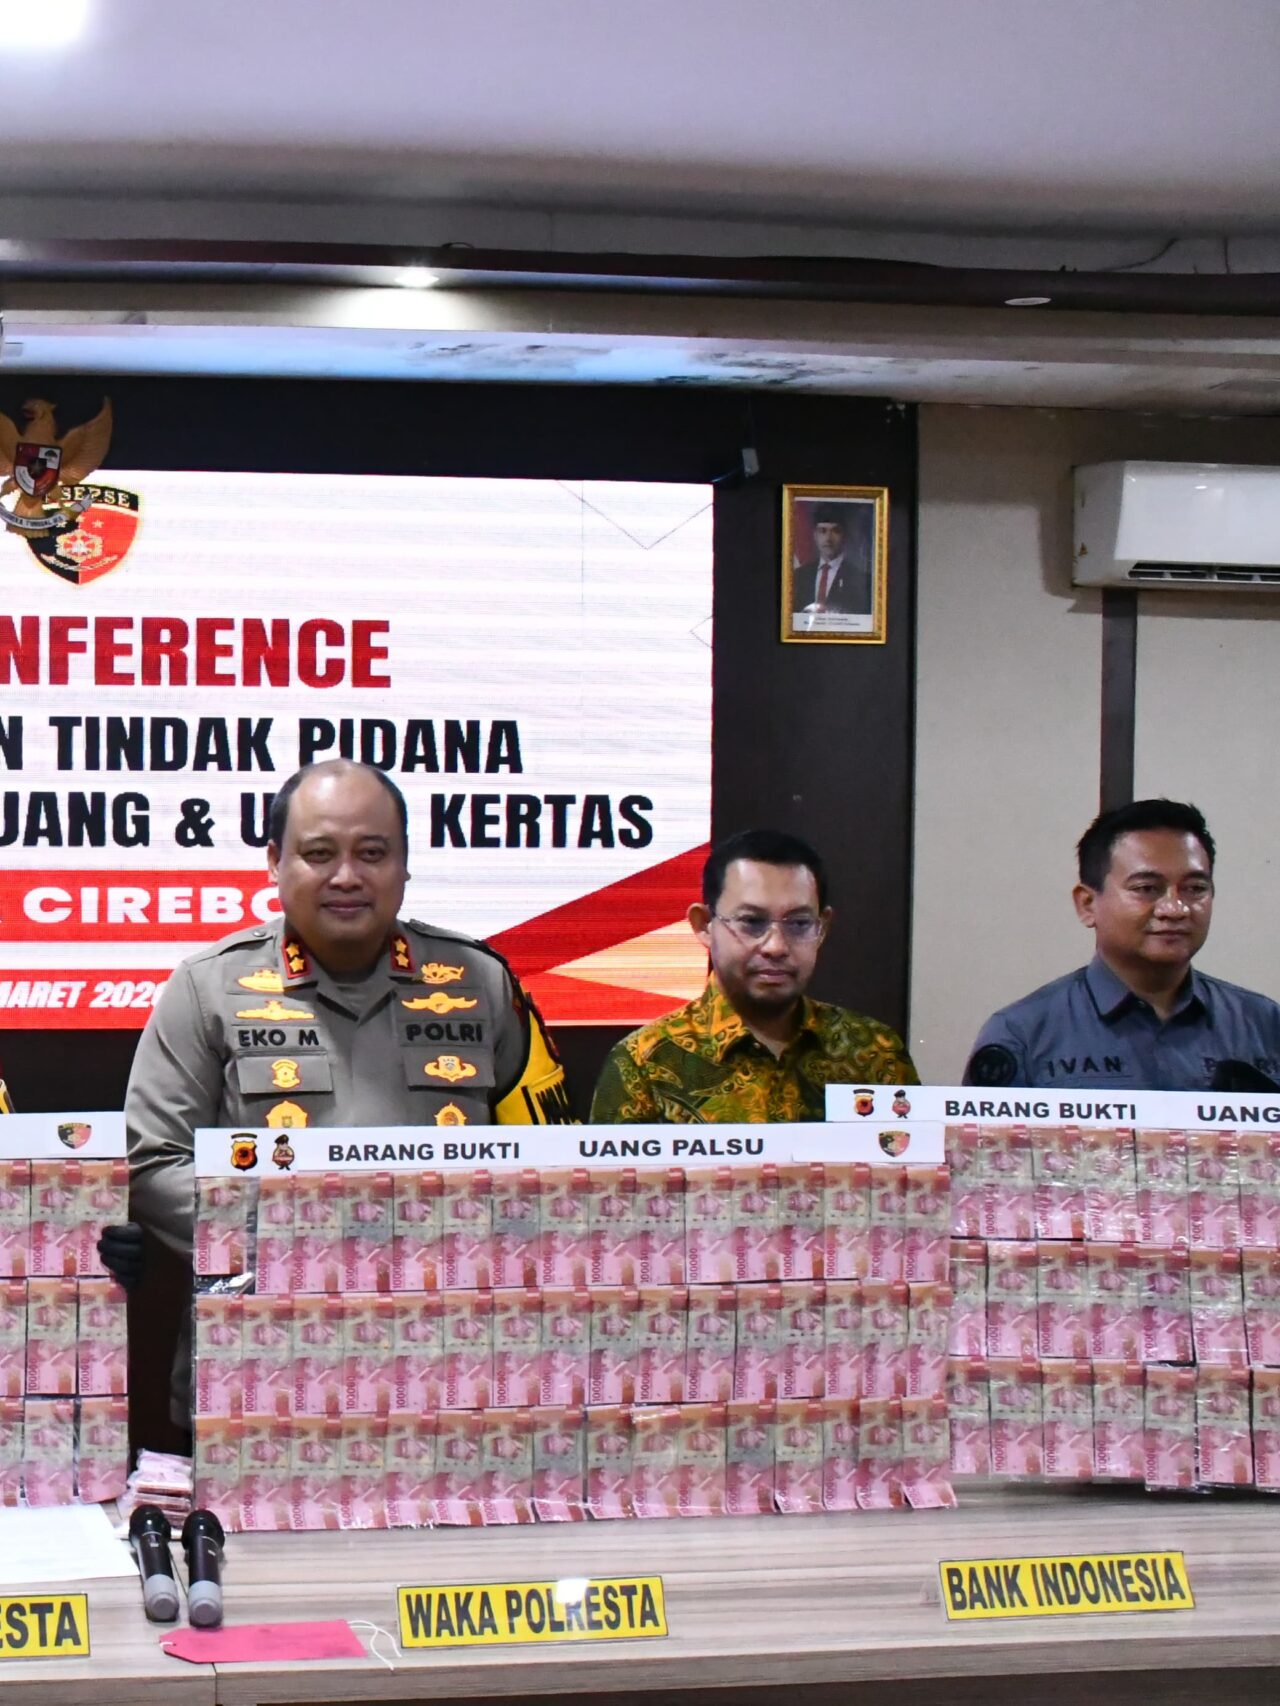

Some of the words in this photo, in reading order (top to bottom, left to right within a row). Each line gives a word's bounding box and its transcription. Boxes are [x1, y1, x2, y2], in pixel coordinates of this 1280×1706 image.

[49, 716, 275, 772] TINDAK
[298, 718, 523, 774] PIDANA
[174, 797, 215, 848] &
[430, 793, 654, 850] KERTAS
[22, 886, 283, 924] CIREBO
[238, 1028, 286, 1047] EKO
[298, 1029, 320, 1047] M
[406, 1023, 483, 1042] POLRI
[1048, 1055, 1122, 1078] IVAN
[945, 1100, 1049, 1119] BARANG
[1059, 1102, 1136, 1121] BUKTI
[1197, 1105, 1280, 1123] UANG
[328, 1144, 434, 1163] BARANG
[443, 1142, 520, 1161] BUKTI
[579, 1140, 661, 1158] UANG
[672, 1138, 764, 1157] PALSU
[946, 1564, 1028, 1611] BANK
[1031, 1557, 1186, 1607] INDONESIA
[405, 1591, 499, 1638] WAKA
[505, 1583, 660, 1634] POLRESTA
